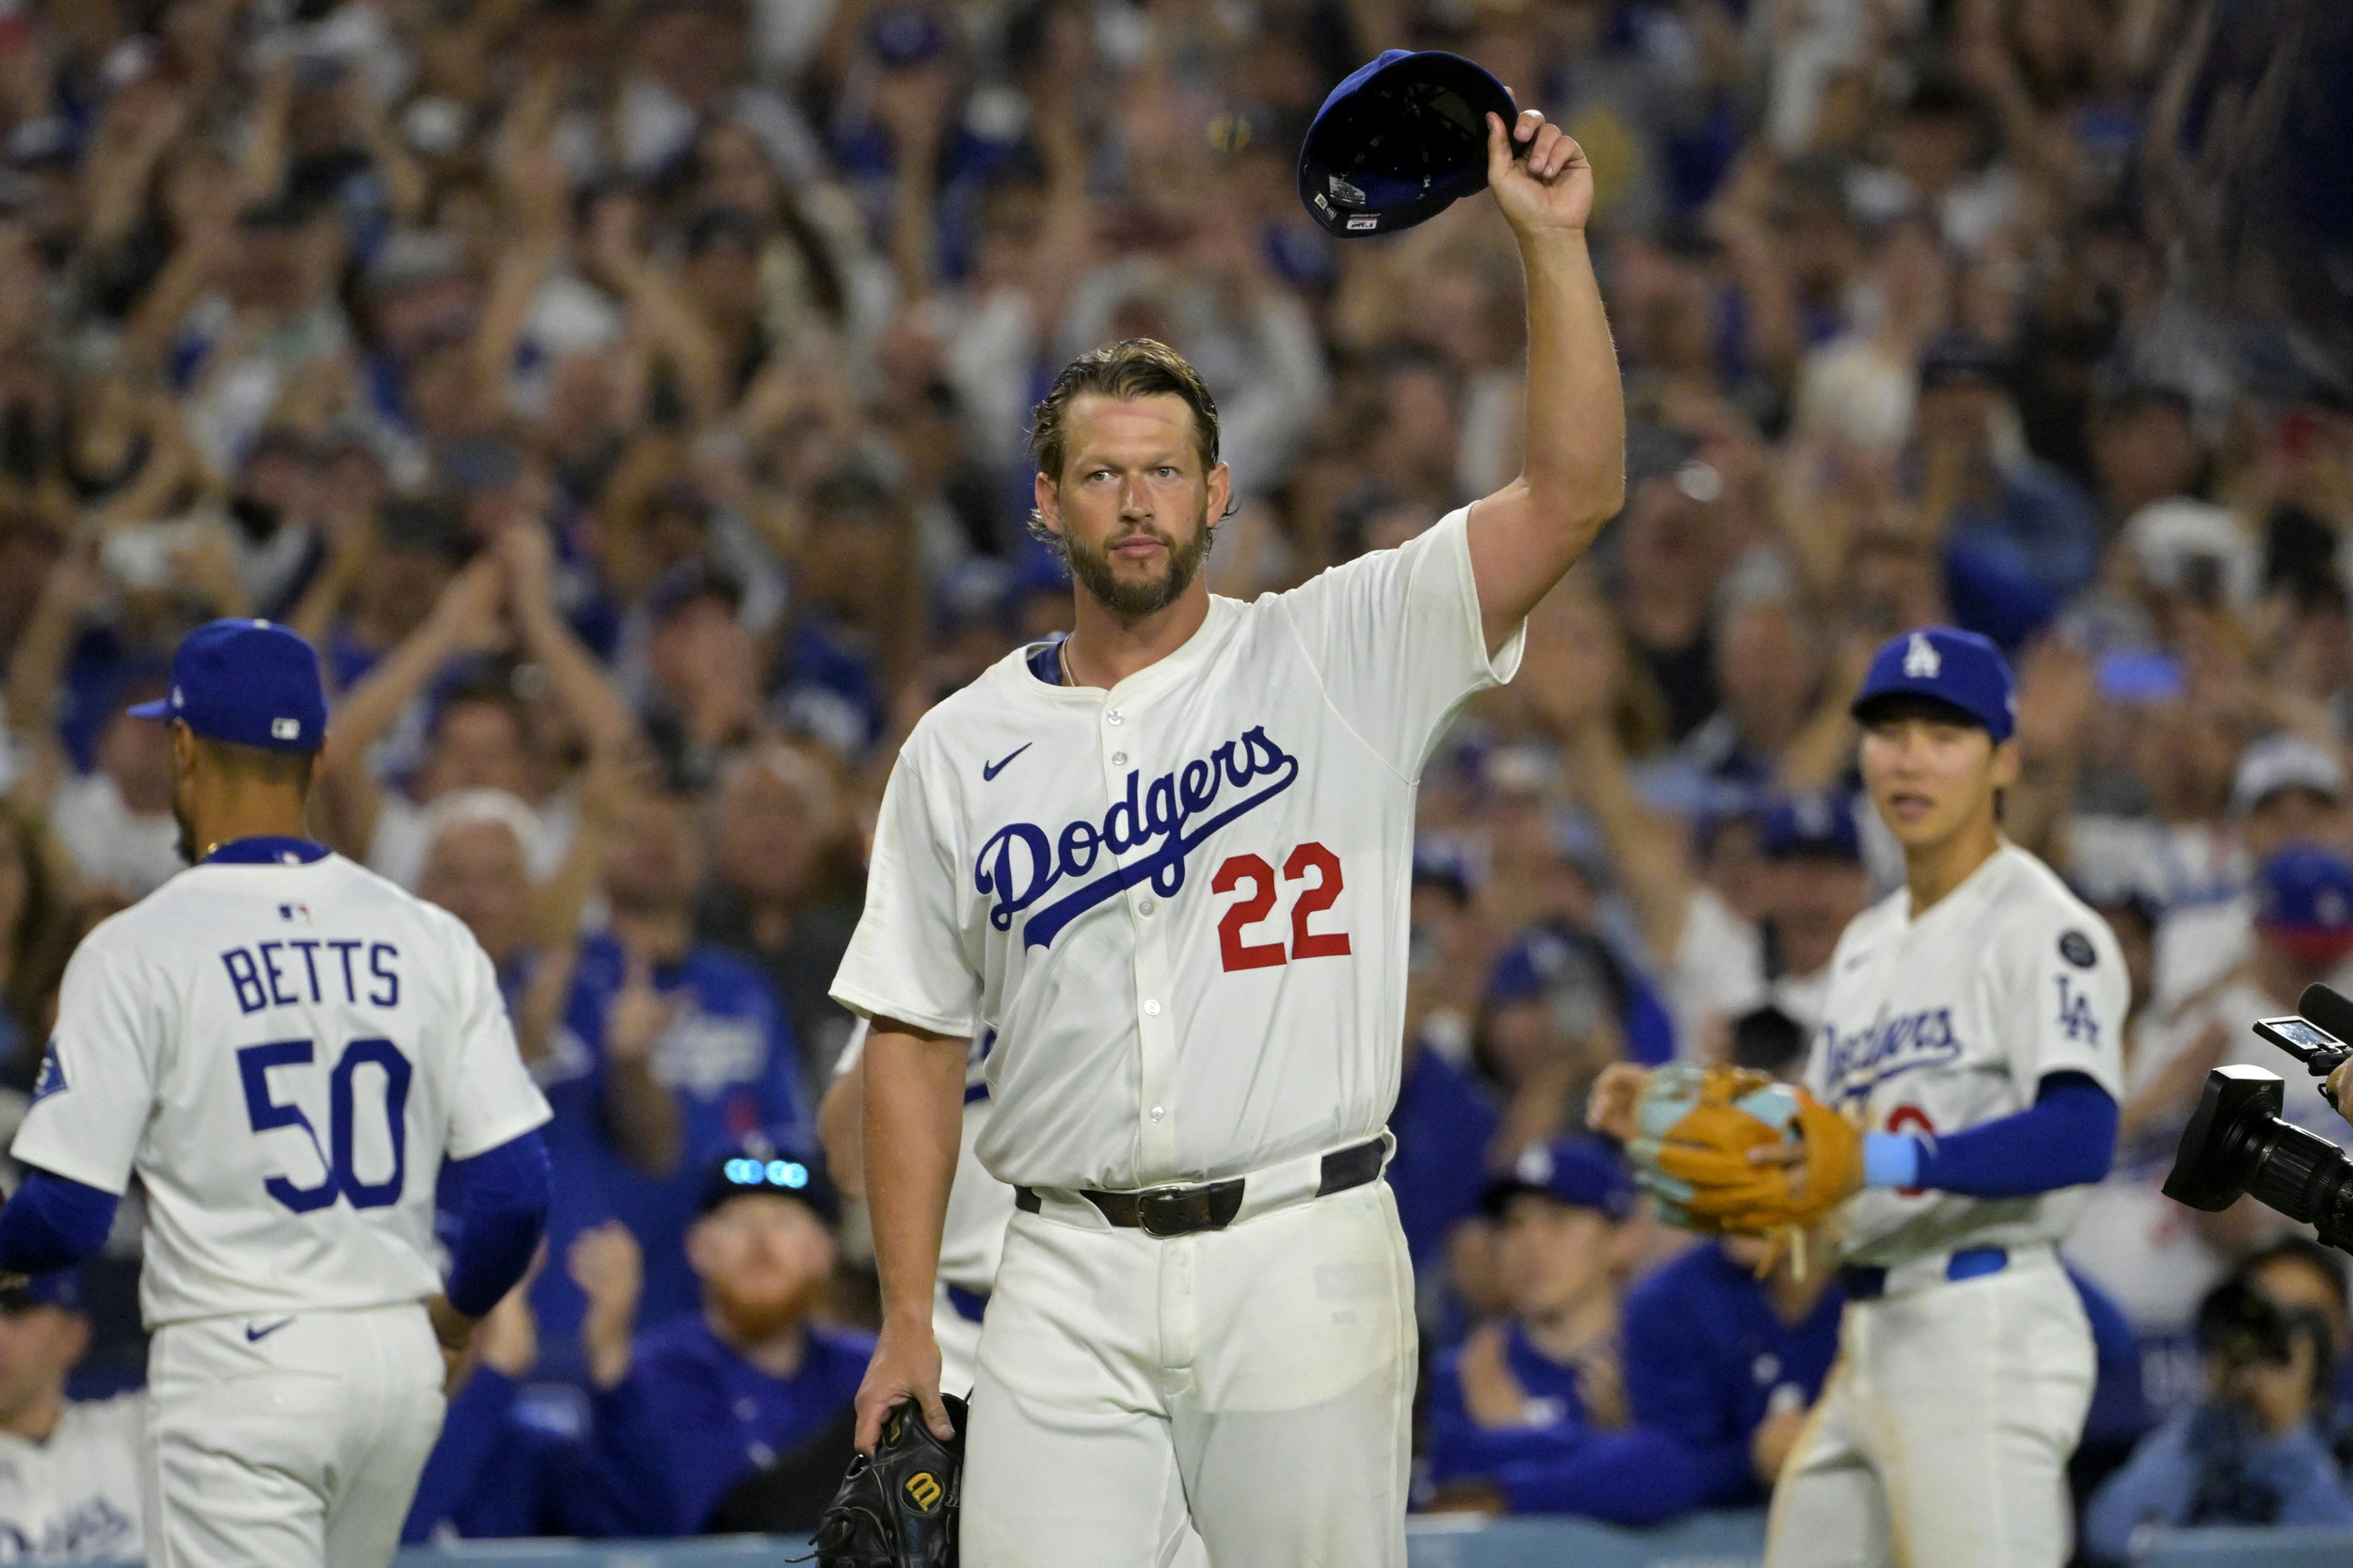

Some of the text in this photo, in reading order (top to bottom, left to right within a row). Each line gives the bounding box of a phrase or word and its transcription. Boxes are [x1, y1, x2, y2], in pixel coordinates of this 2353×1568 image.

[975, 726, 1299, 951] Dodgers
[1211, 841, 1352, 973] 22
[221, 940, 399, 1014] BETTS
[2056, 975, 2100, 1048] LA
[236, 1038, 411, 1212] 50
